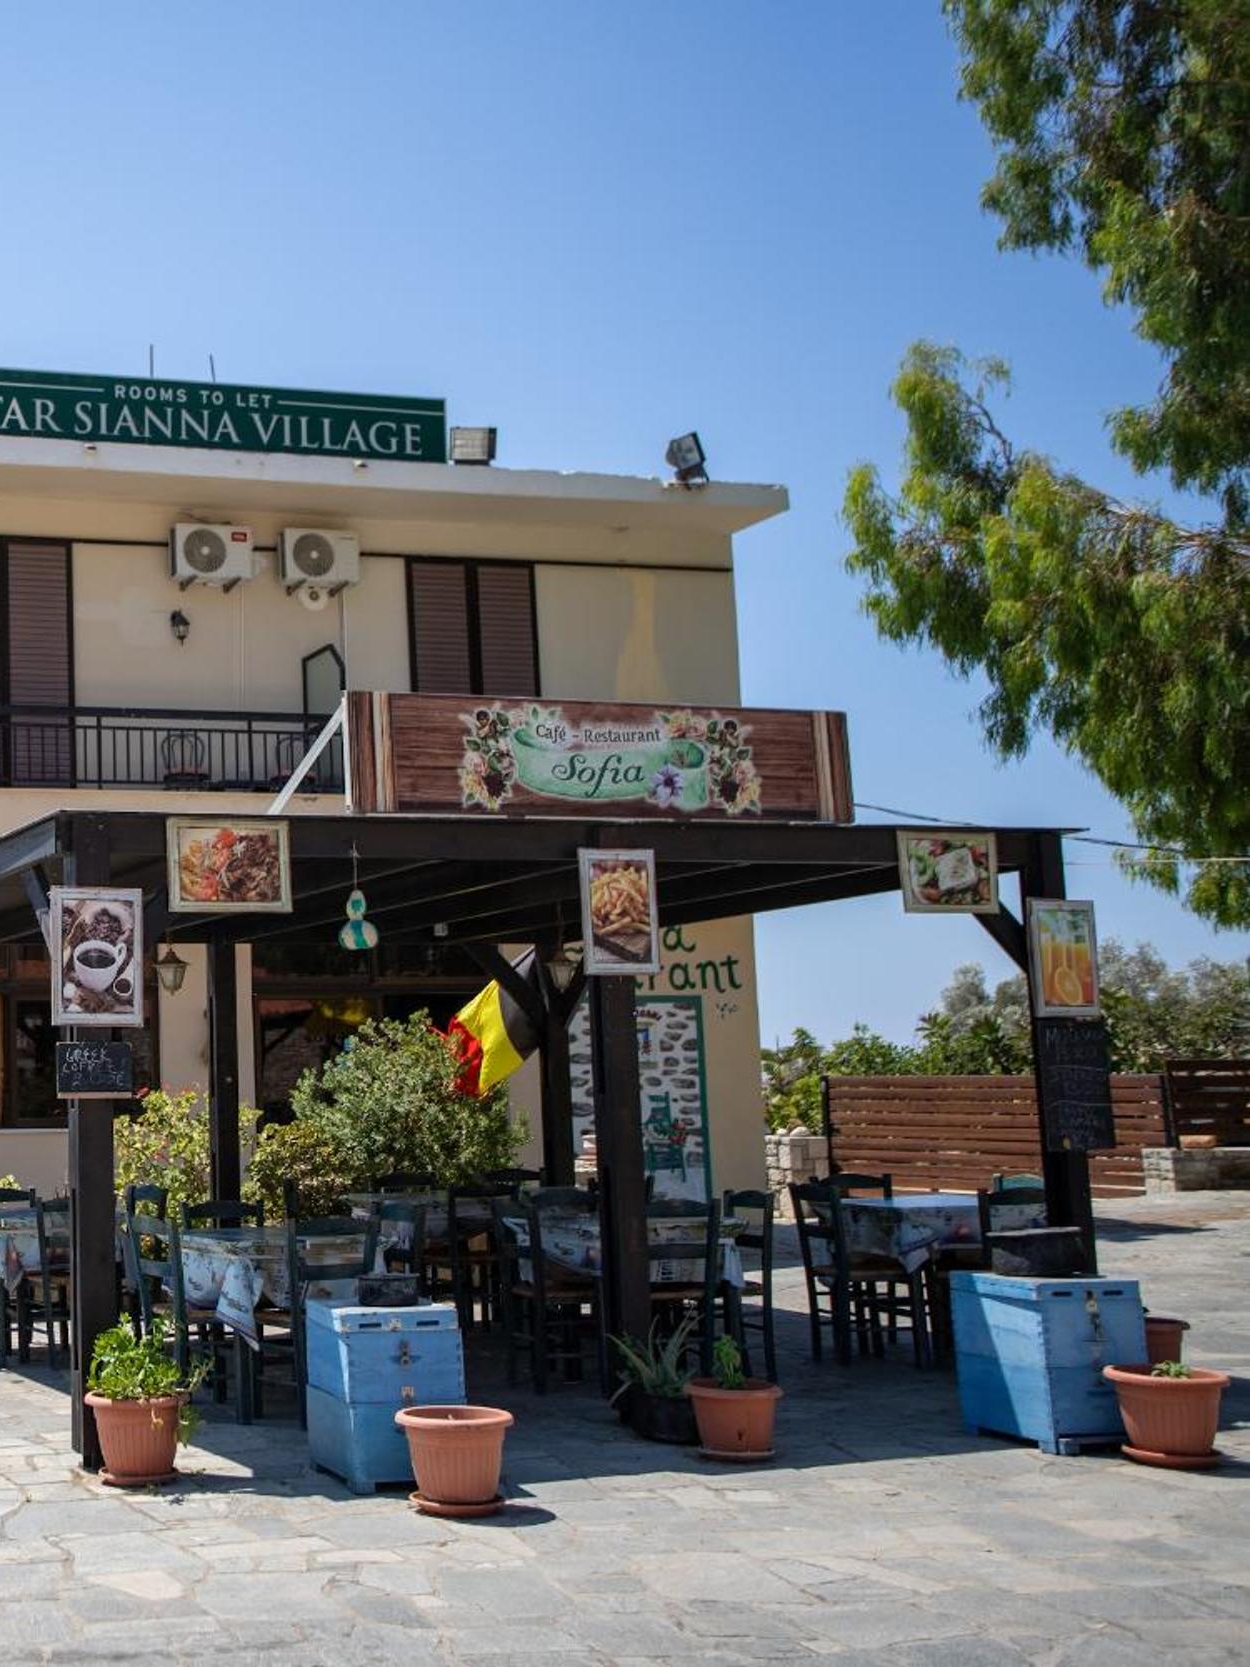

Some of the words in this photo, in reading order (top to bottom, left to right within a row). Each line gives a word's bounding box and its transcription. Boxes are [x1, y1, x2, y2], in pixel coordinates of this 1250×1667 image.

[114, 384, 188, 403] ROOMS
[200, 390, 224, 406] TO
[236, 392, 273, 409] LET
[74, 400, 242, 444] SIANNA
[250, 412, 423, 456] VILLAGE
[536, 724, 566, 744] Café
[584, 729, 661, 743] Restaurant
[551, 753, 645, 798] Sofia
